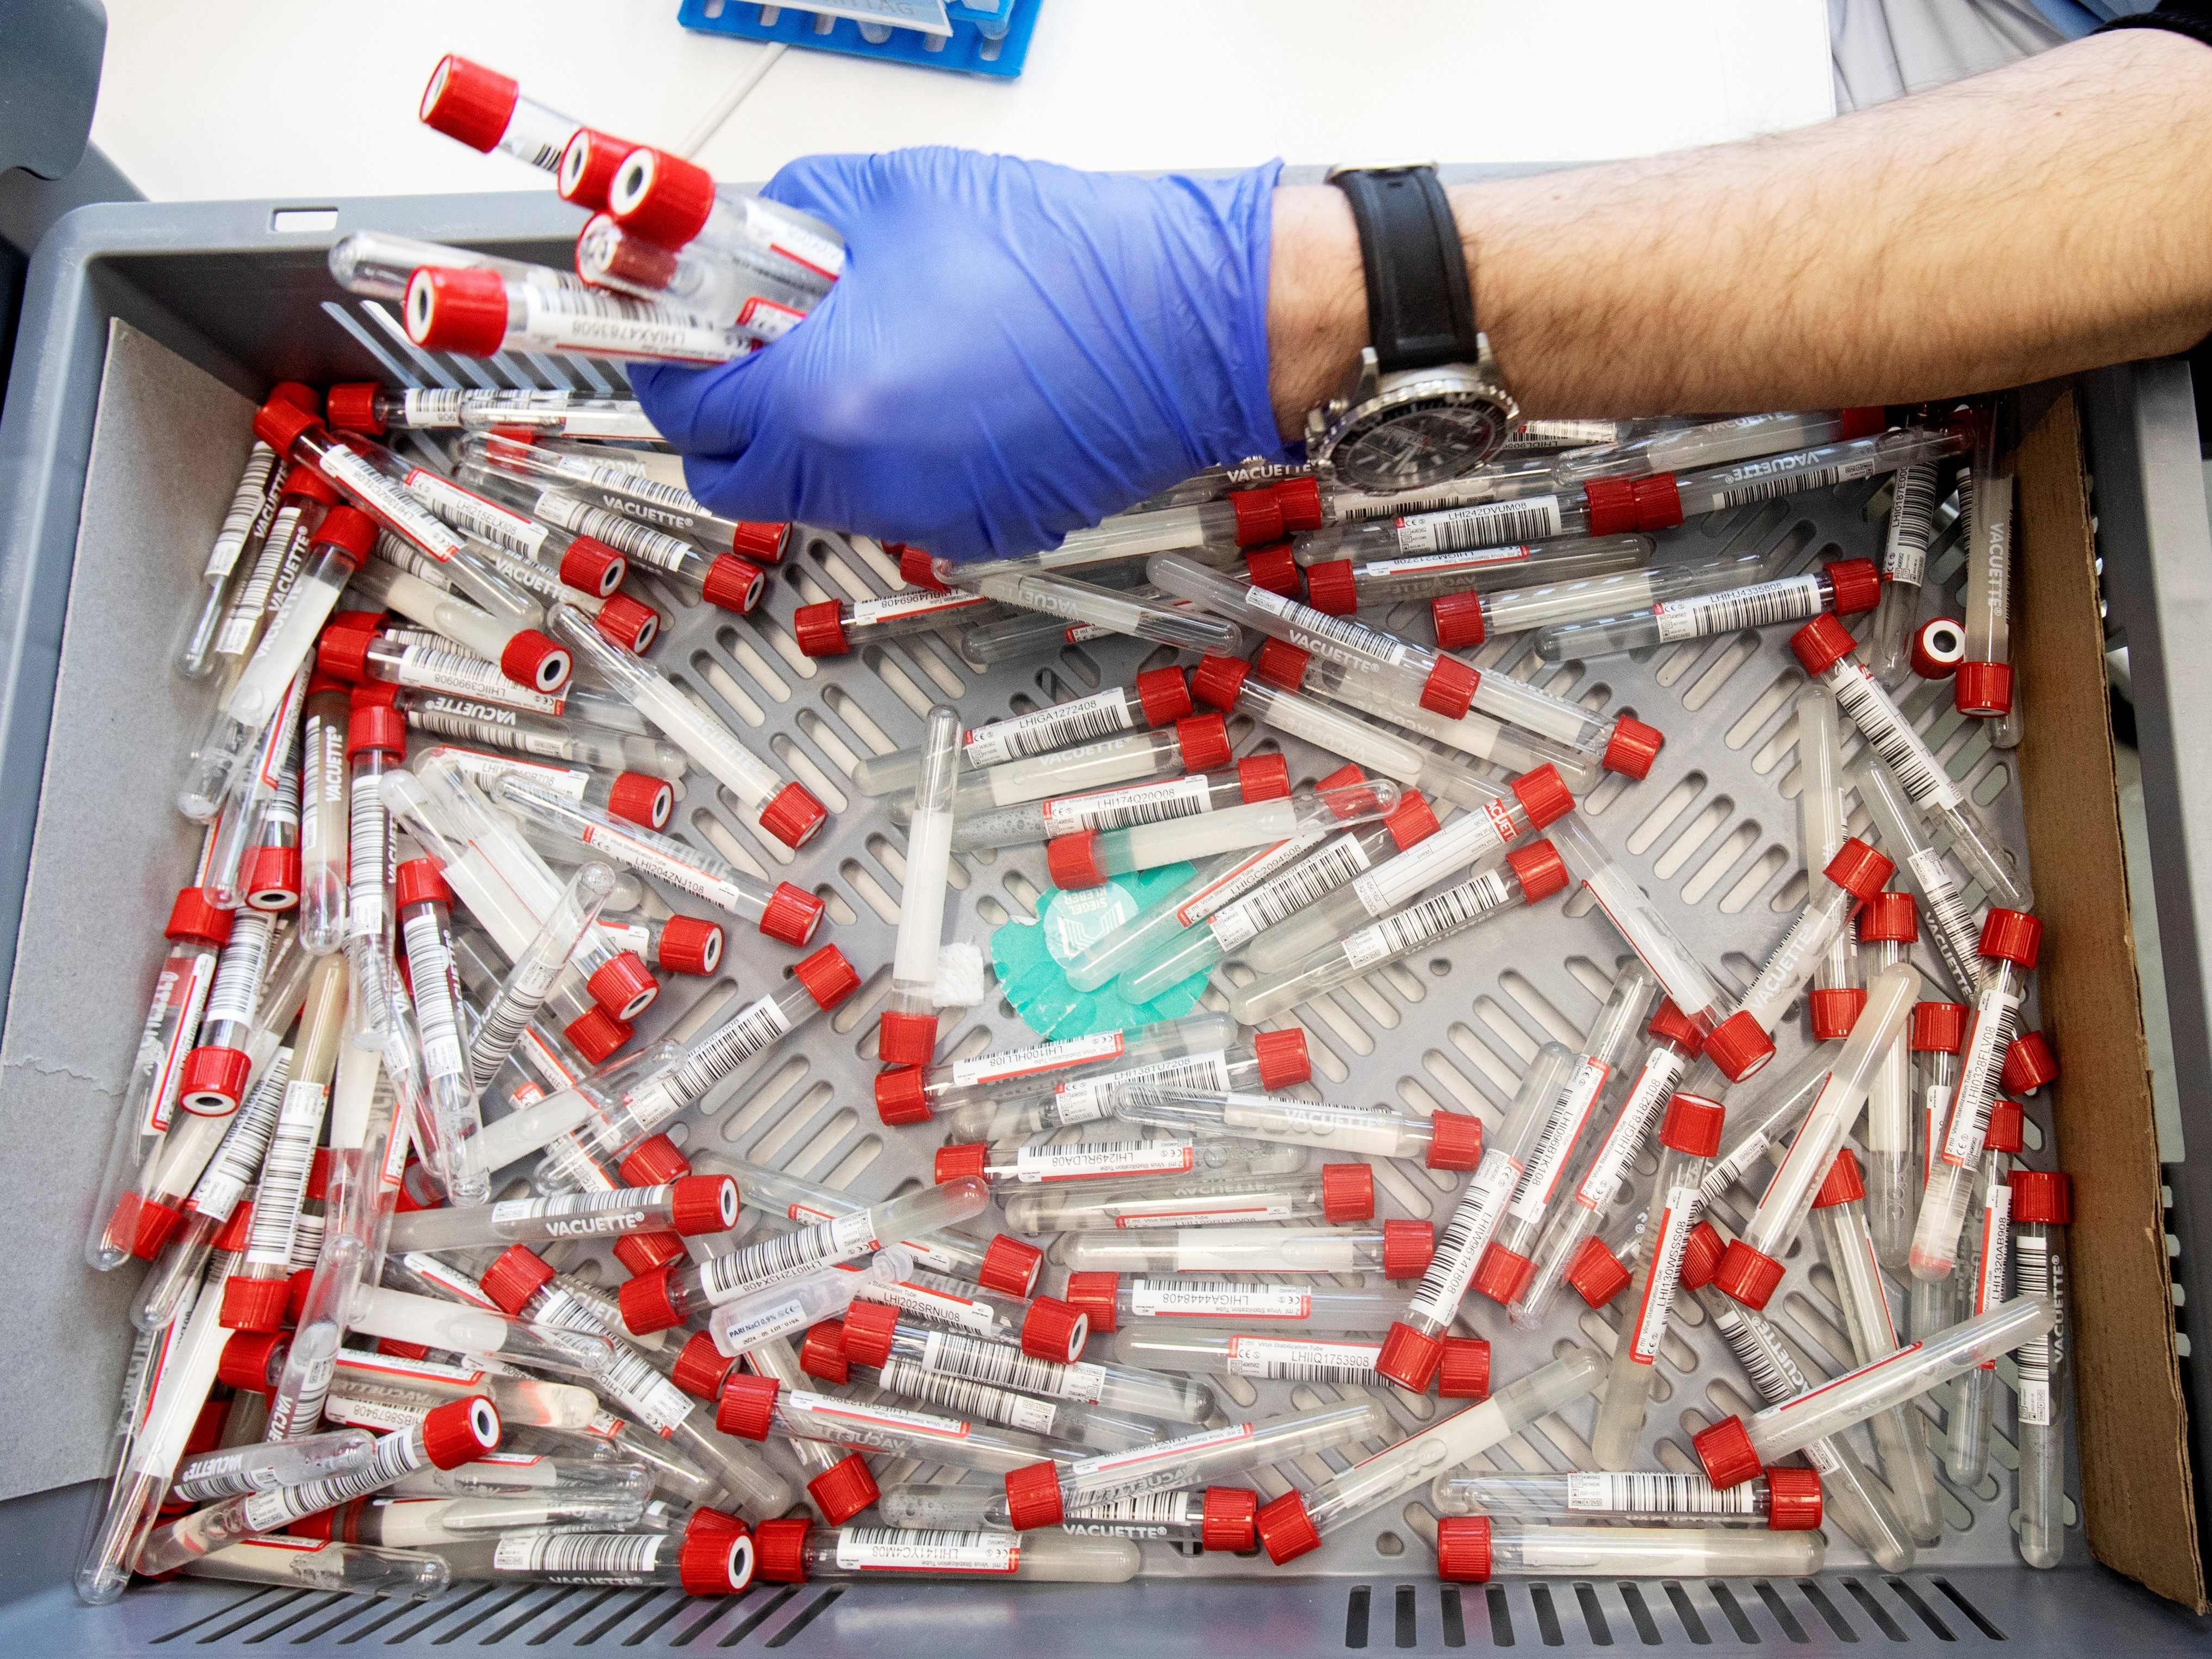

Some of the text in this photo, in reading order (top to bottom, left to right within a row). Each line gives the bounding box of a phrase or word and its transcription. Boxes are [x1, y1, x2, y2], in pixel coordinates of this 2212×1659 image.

[1448, 501, 1527, 522] LHI242DVUM08
[1711, 582, 1783, 603] LHIHJ4335808
[1019, 699, 1097, 728] LHIGA1272408
[634, 857, 706, 894] LHI204ZNJ108
[1229, 844, 1302, 895] LHIGC2094508
[1189, 902, 1199, 912] ml
[1199, 893, 1213, 906] Virus
[1241, 866, 1255, 878] Tube
[1963, 1069, 1972, 1083] Tube
[1966, 1025, 1995, 1105] LHI0328FLV08
[1615, 1078, 1661, 1155] LHIGF8182108
[1955, 1085, 1968, 1118] Stabilization
[1948, 1137, 1956, 1147] ml
[1951, 1119, 1960, 1134] Virus
[1051, 1152, 1133, 1166] LHI249RLDA08
[1531, 1111, 1574, 1187] LHI096BTK108
[1585, 1180, 1594, 1190] ml
[1591, 1164, 1603, 1179] Virus
[1599, 1133, 1621, 1165] Stabilization
[1617, 1120, 1628, 1134] Tube
[1445, 1211, 1493, 1295] LHIW96141808
[1656, 1220, 1687, 1307] LHI130WSSS08
[1991, 1217, 2007, 1299] LHI1320AB908
[741, 1259, 822, 1292] LHI012H3X408
[1655, 1268, 1664, 1284] Tube
[882, 1291, 961, 1323] LHI202SRNU08
[1162, 1293, 1248, 1305] LHIGA4448408
[1646, 1284, 1660, 1319] Stabilization
[729, 1328, 745, 1338] PARI
[745, 1321, 761, 1331] NaCl
[1639, 1337, 1647, 1347] ml
[1642, 1319, 1651, 1335] Virus
[1292, 1351, 1370, 1367] LHIIQ1753908
